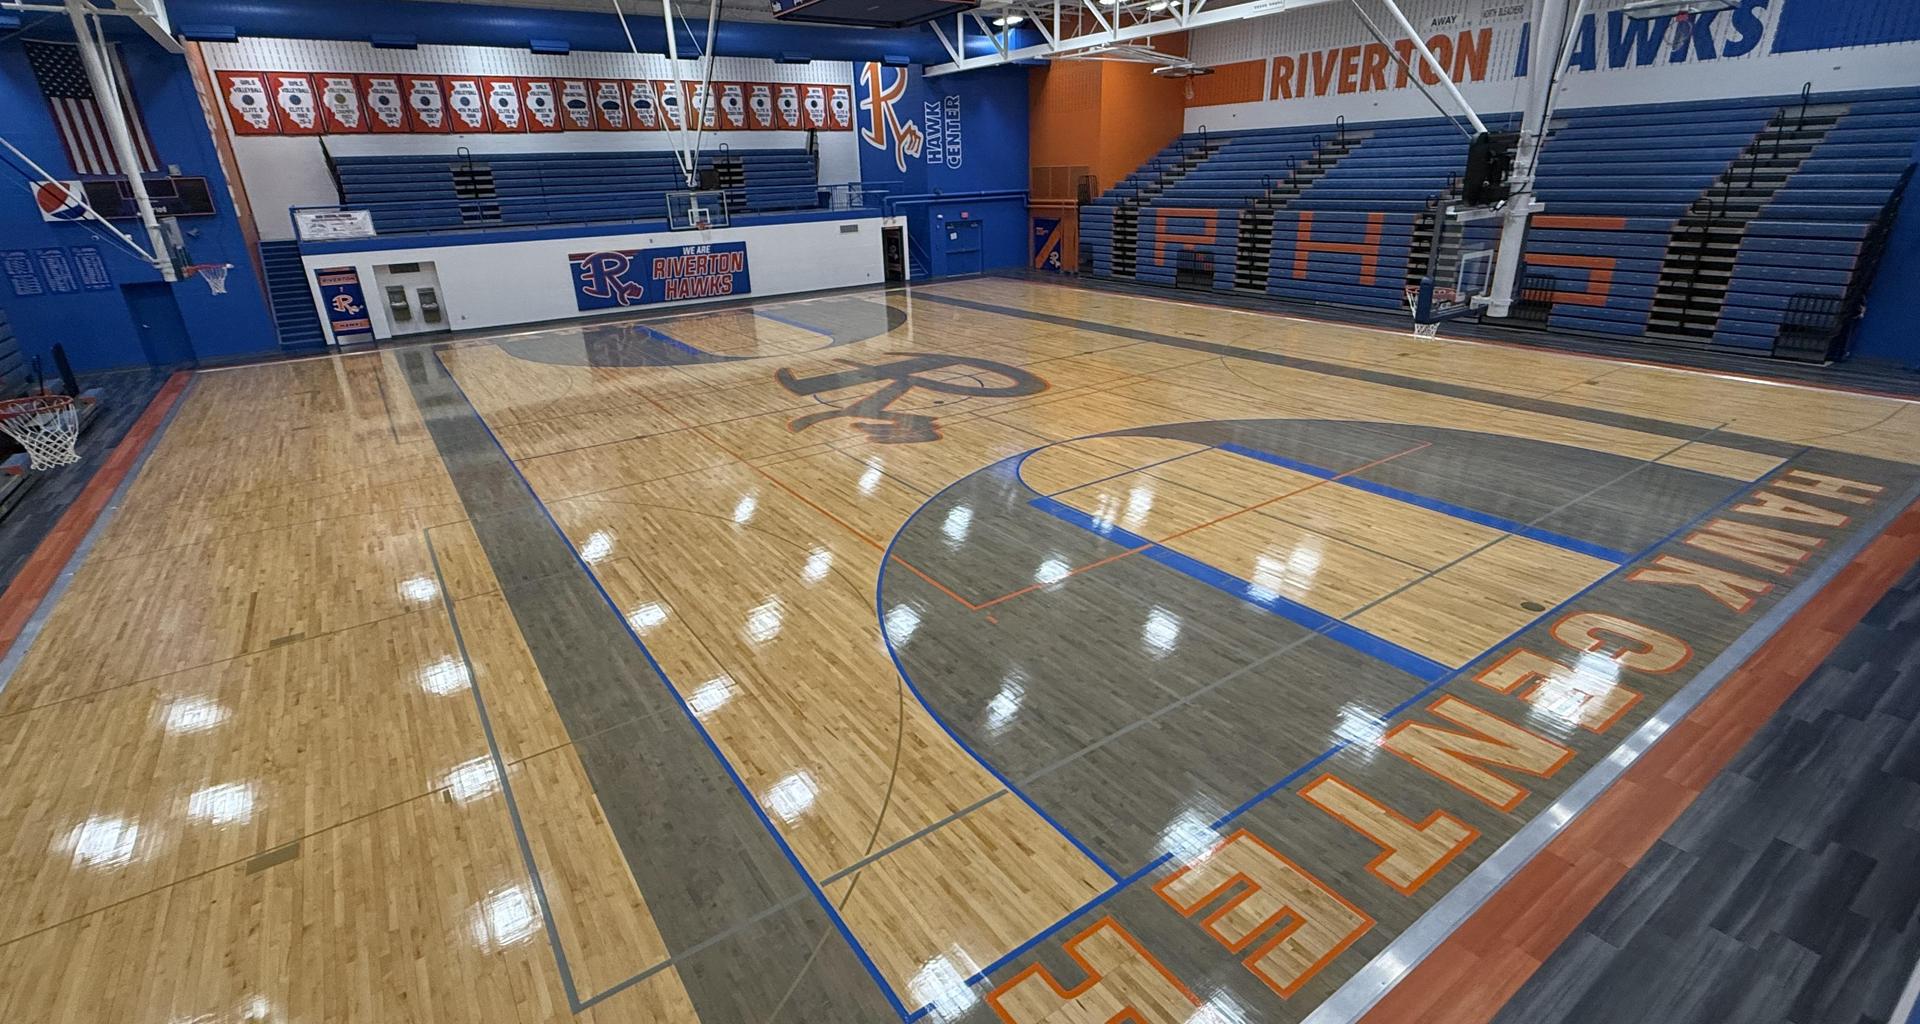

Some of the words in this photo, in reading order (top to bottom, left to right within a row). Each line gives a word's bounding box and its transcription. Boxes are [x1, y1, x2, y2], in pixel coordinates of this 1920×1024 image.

[1431, 15, 1457, 27] AWAY
[1270, 28, 1493, 100] RIVERTON
[924, 101, 943, 164] HAWK
[944, 95, 962, 169] CENTER
[652, 251, 743, 280] RIVERTON
[682, 246, 695, 255] WE
[696, 245, 711, 254] ARE
[665, 274, 733, 300] HAWKS
[1624, 468, 1888, 614] HAWK
